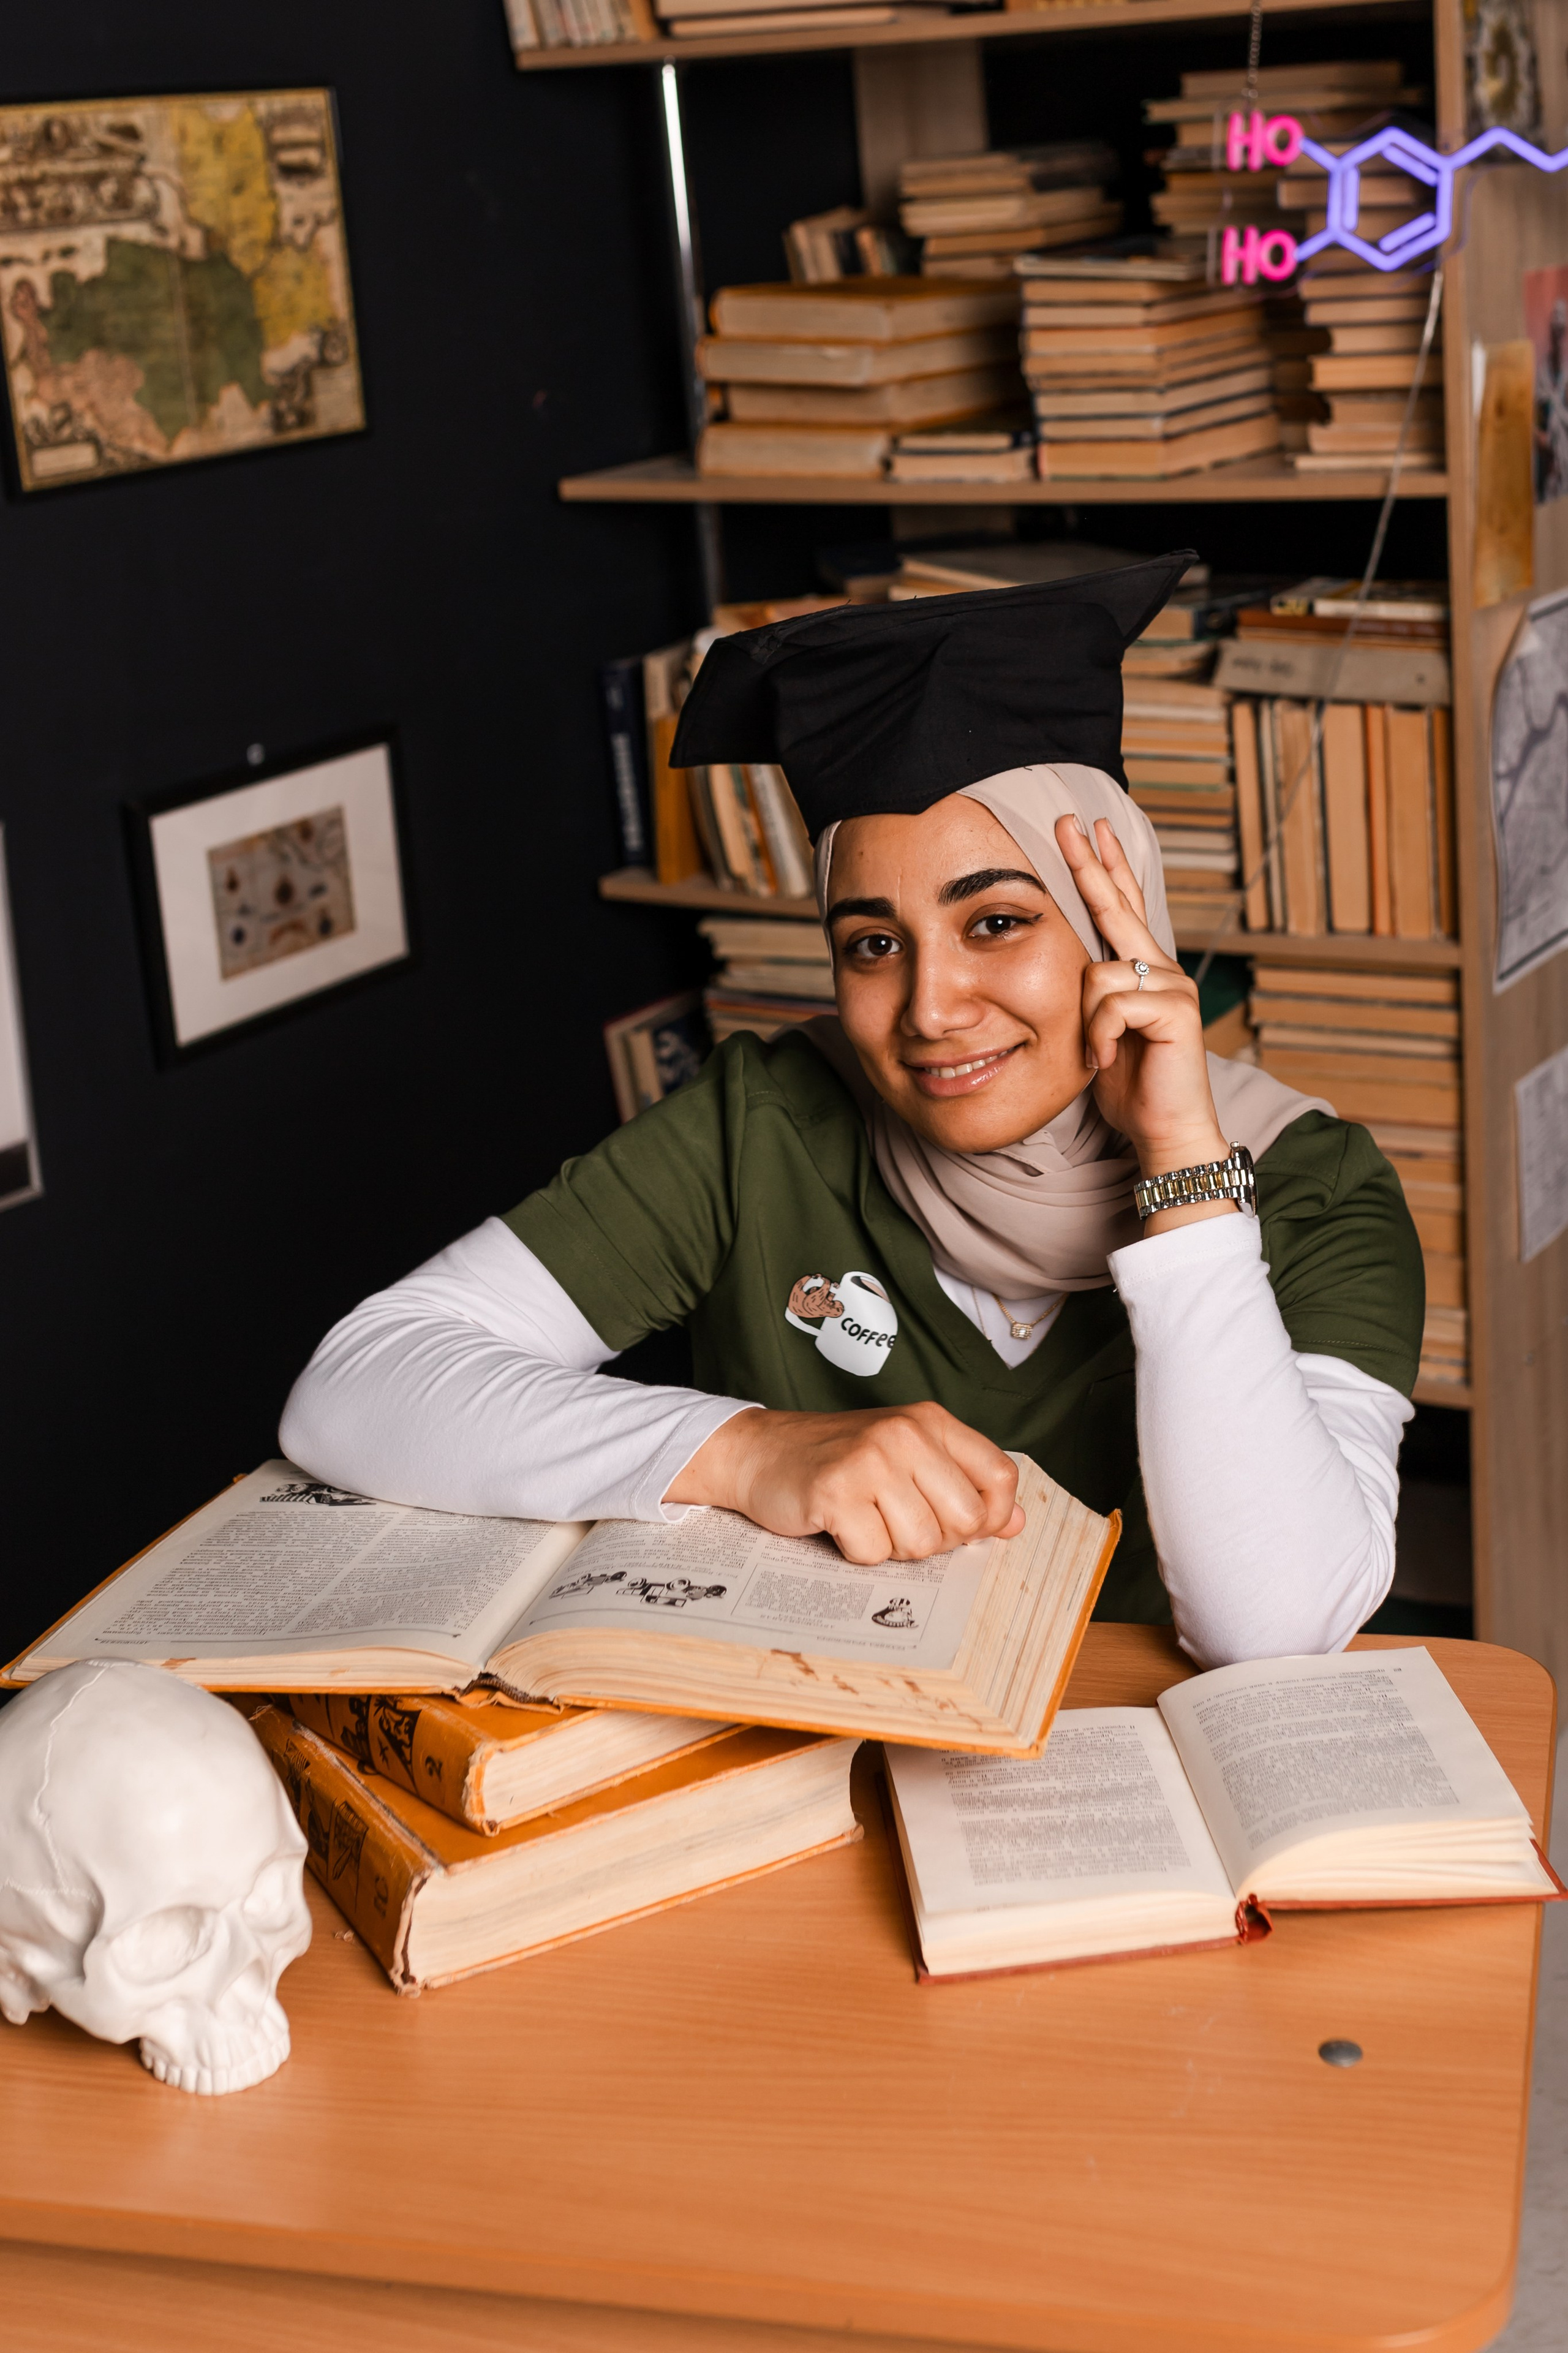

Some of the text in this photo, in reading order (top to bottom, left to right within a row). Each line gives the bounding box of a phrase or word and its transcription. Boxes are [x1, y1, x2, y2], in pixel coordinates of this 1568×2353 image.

[1226, 109, 1305, 172] HO
[1221, 224, 1298, 286] HO
[425, 1755, 443, 1783] 2
